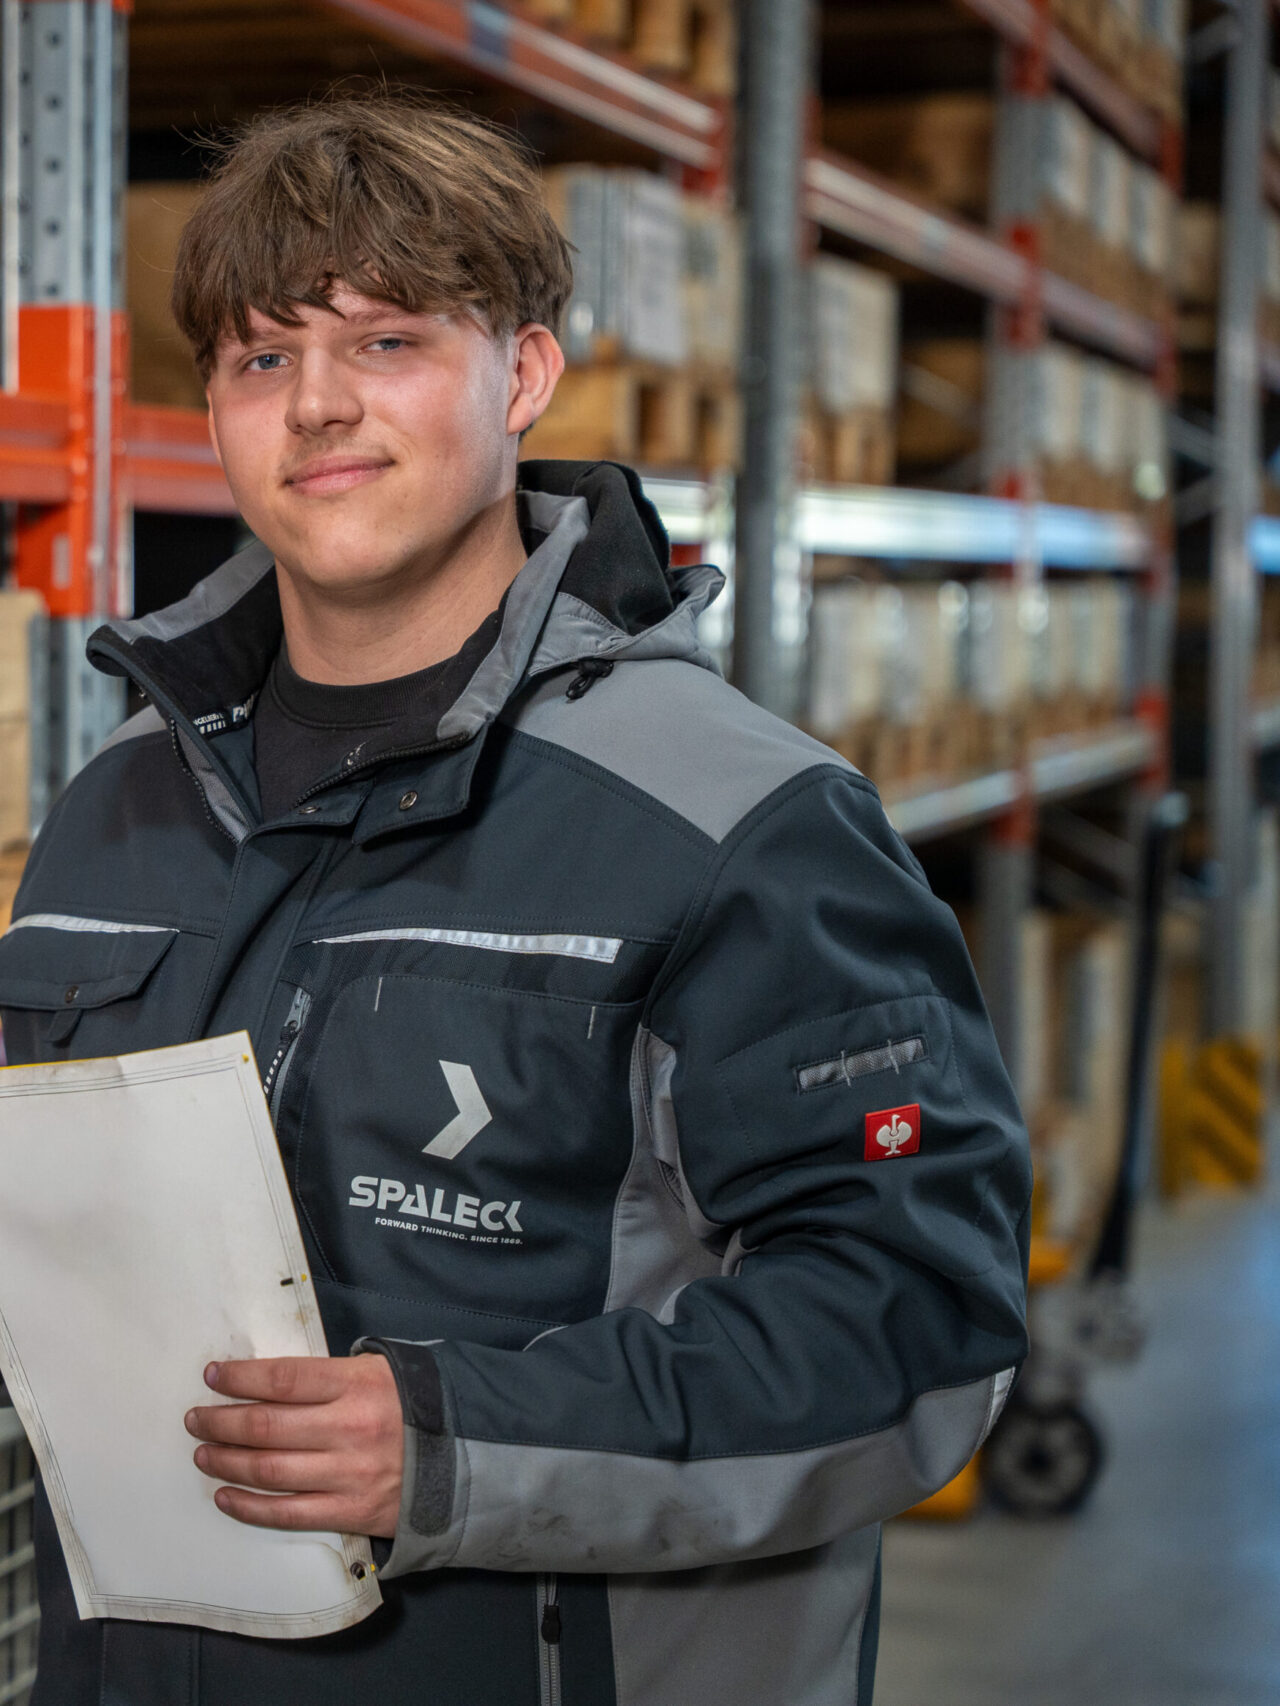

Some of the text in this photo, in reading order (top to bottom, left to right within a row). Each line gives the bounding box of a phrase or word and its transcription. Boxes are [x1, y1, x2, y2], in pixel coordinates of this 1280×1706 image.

[375, 1217, 419, 1232] FORWARD
[421, 1225, 469, 1241] THINKING.
[470, 1234, 499, 1244] SINCE
